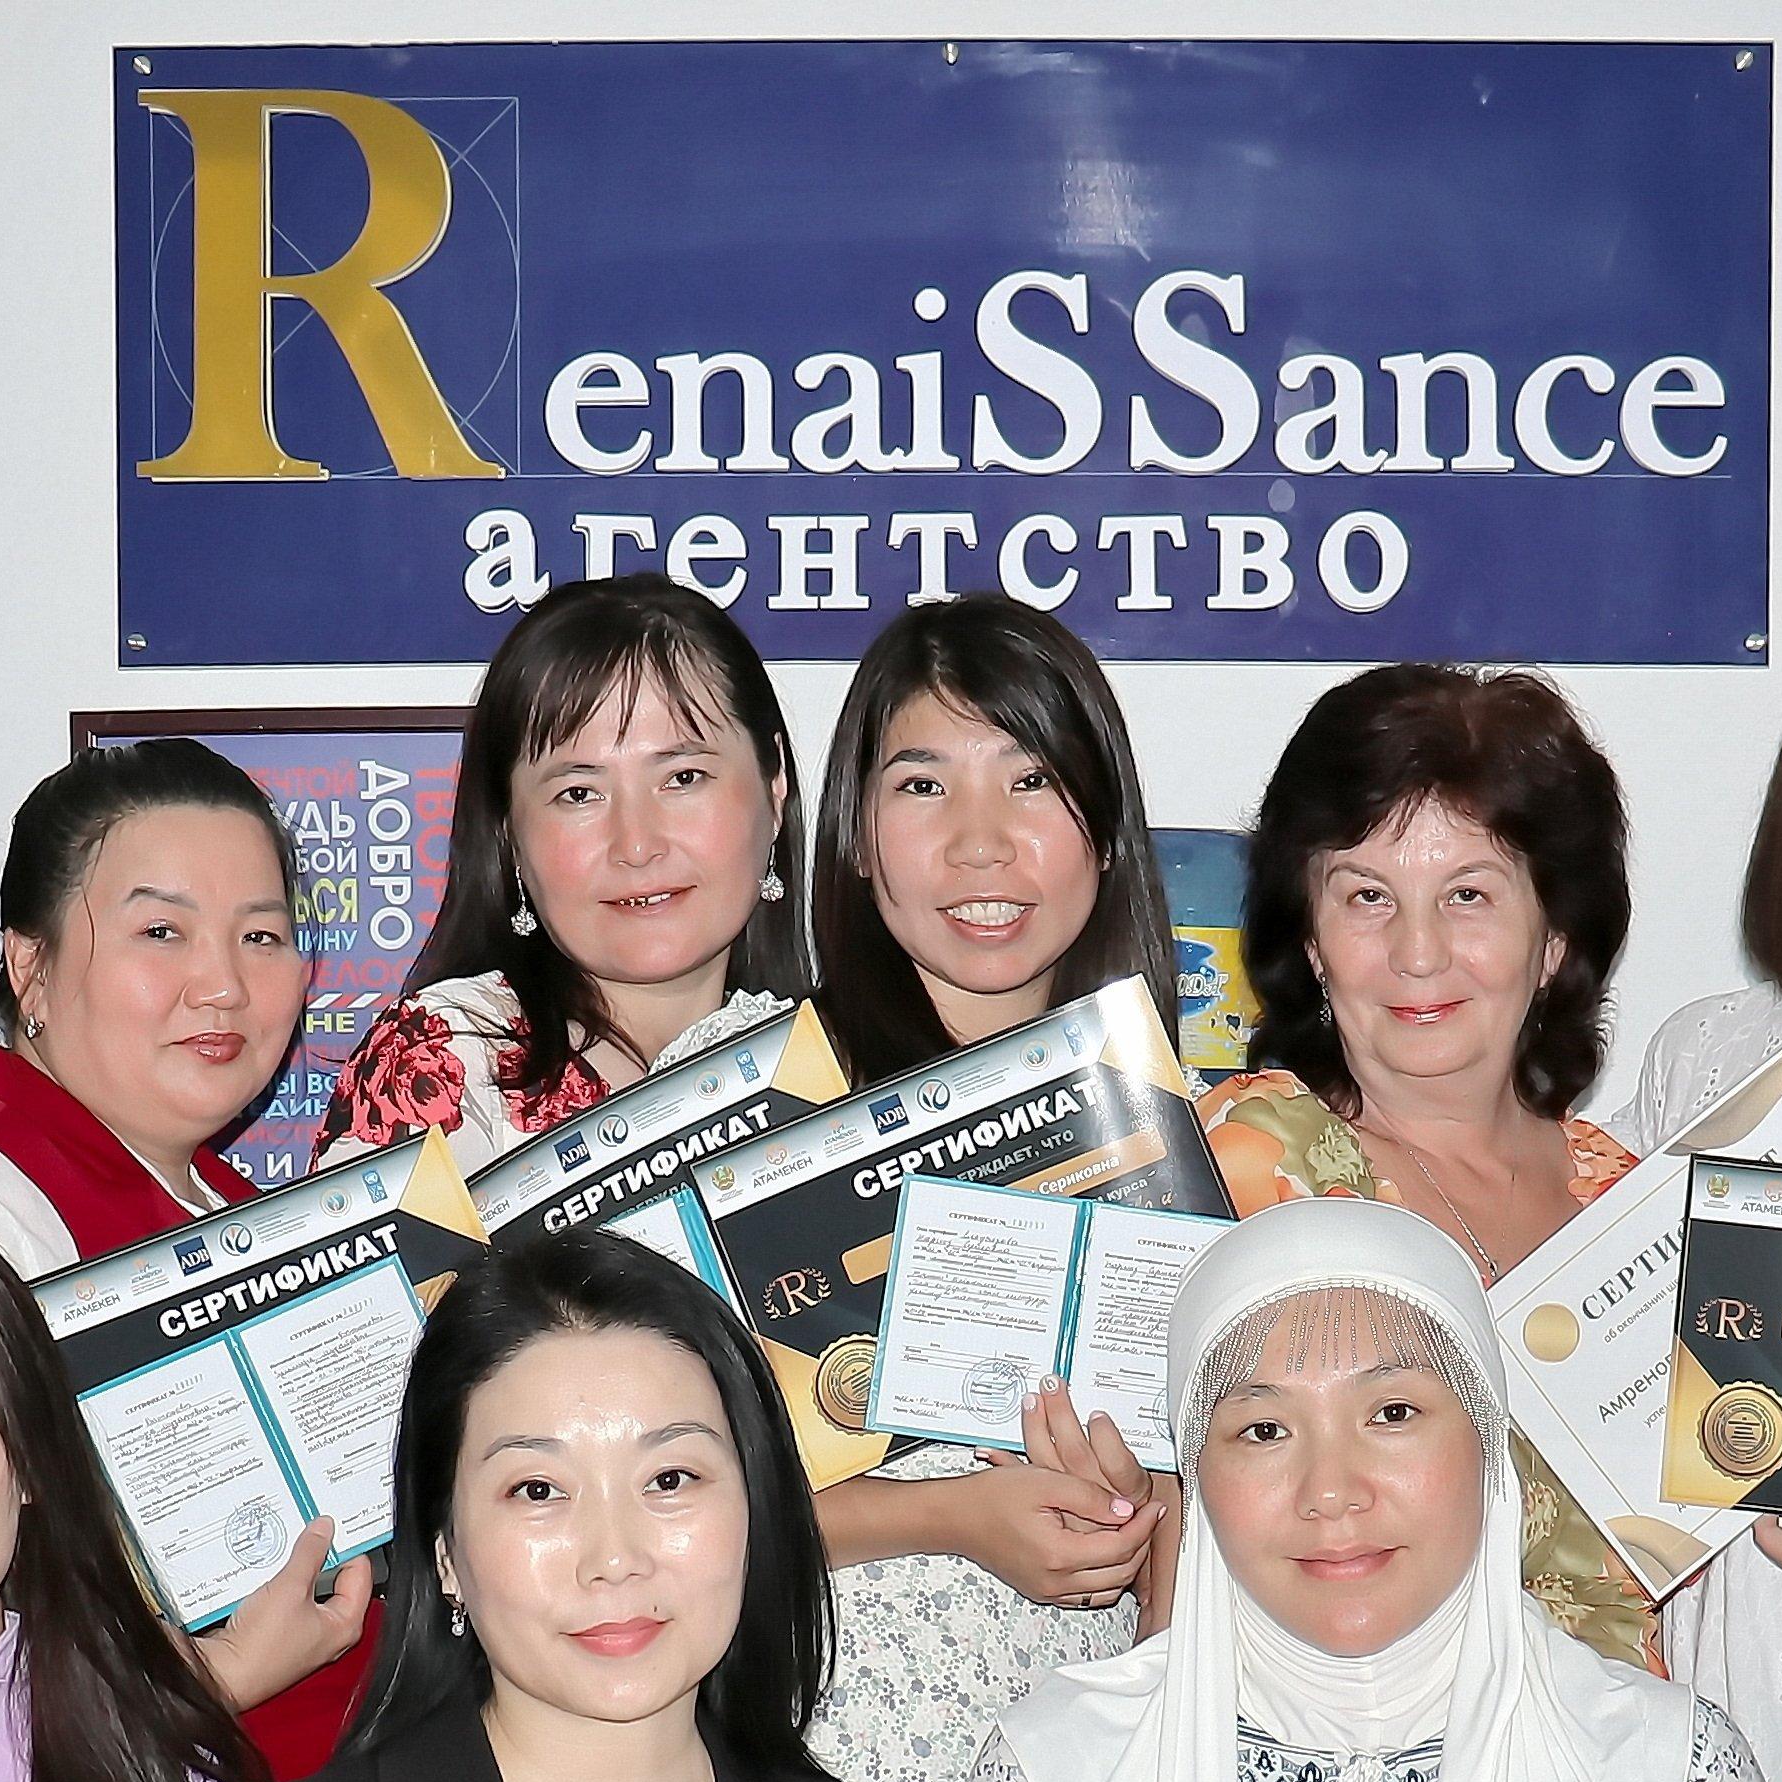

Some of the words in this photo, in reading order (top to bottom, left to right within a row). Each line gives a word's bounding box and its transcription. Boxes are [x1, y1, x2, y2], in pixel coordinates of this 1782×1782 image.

[463, 506, 1410, 613] агентство
[284, 800, 357, 845] УДЬ
[295, 841, 357, 874] БОЙ
[359, 760, 414, 950] ДОБРО
[305, 1012, 355, 1033] НЕ
[853, 1078, 1097, 1198] СЕРТИФИКАТ
[876, 1106, 906, 1131] ADB
[543, 1101, 770, 1235] СЕРТИФИКАТ
[560, 1142, 589, 1168] ADB
[752, 1156, 813, 1188] АТАМЕКЕН
[1038, 1155, 1120, 1196] Сериковна
[181, 1246, 210, 1271] ADB
[1582, 1220, 1685, 1320] СЕРТИ
[159, 1224, 398, 1339] СЕРТИФИКАТ
[63, 1293, 121, 1323] АТАМЕКЕН
